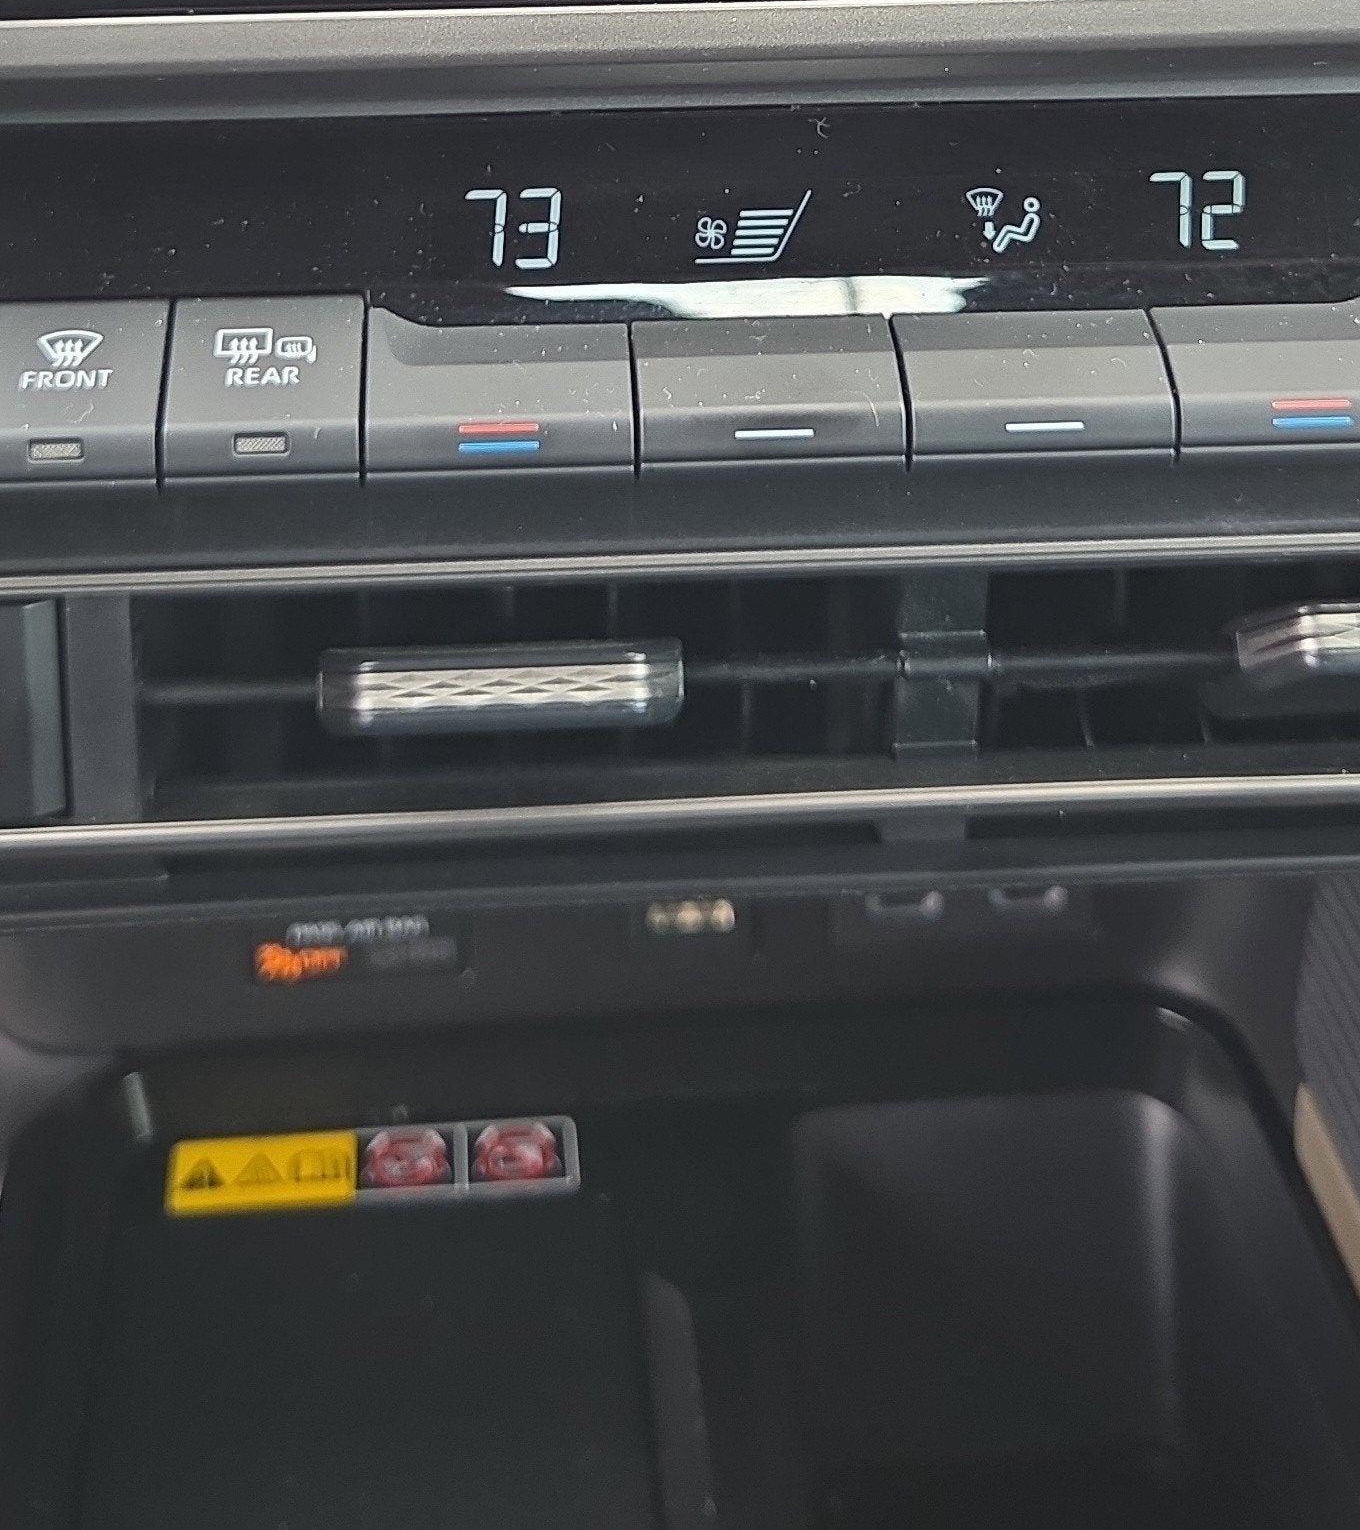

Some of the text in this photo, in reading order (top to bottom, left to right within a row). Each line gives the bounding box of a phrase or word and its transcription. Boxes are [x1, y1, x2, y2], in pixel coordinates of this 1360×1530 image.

[464, 187, 562, 270] 73
[1149, 170, 1245, 251] 72
[18, 367, 114, 391] FRONT
[224, 364, 301, 387] REAR
